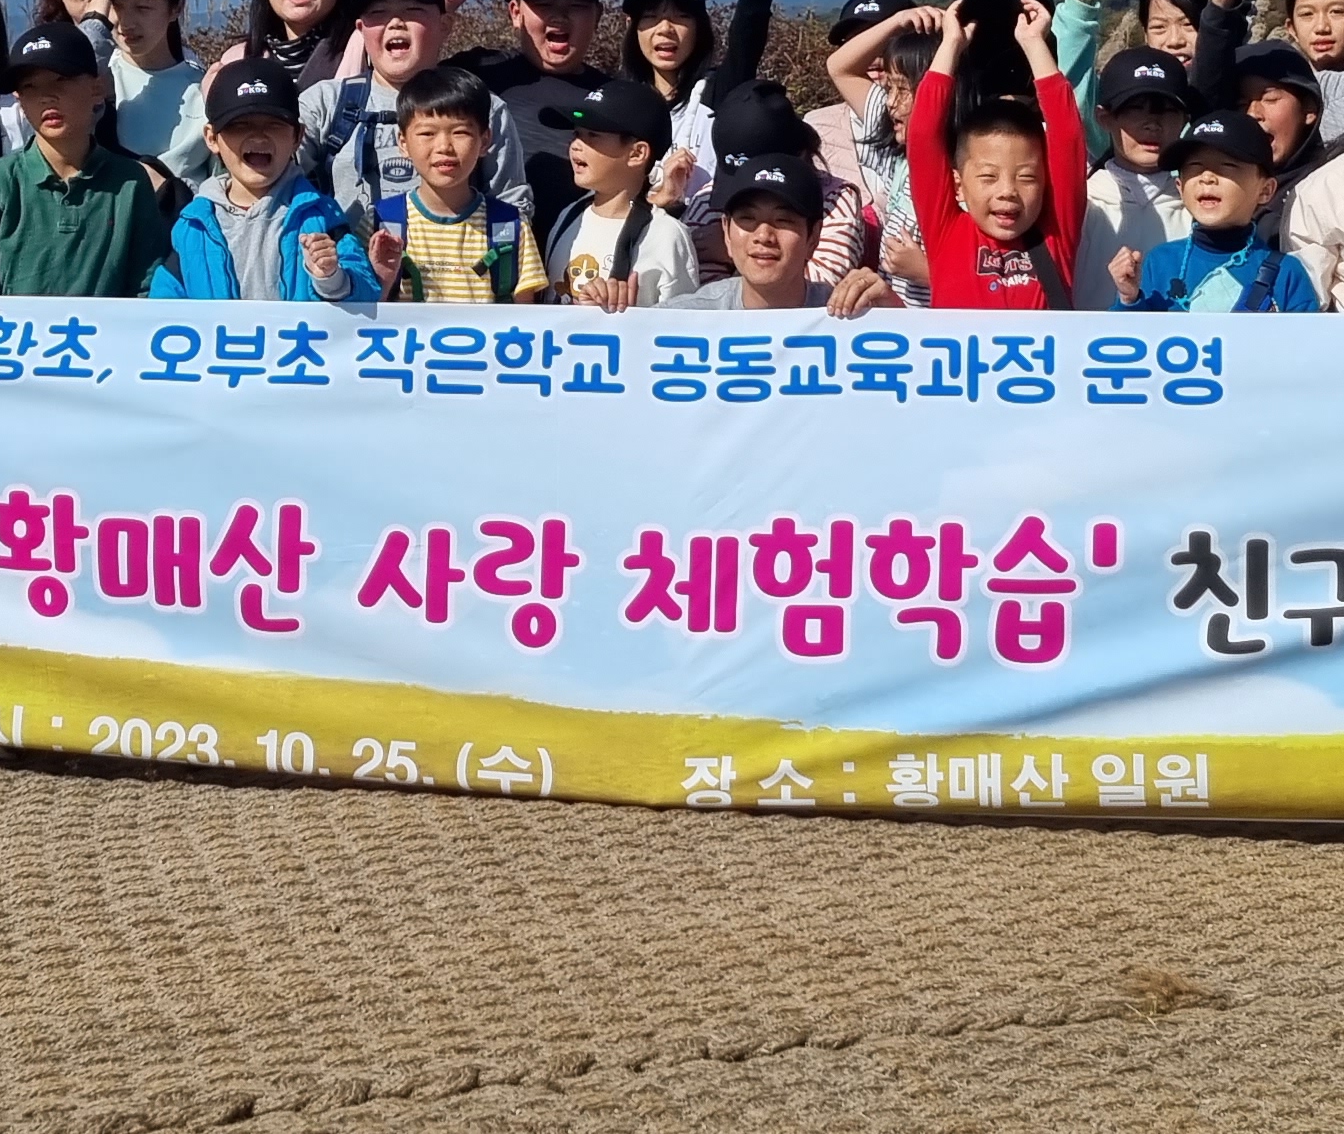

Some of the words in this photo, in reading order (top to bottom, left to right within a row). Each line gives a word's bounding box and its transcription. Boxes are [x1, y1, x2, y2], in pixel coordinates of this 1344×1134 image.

[140, 321, 330, 388] 오부초
[356, 325, 625, 397] 작은학교
[651, 331, 1056, 404] 공동교육과정
[1082, 336, 1225, 405] 운영
[357, 519, 581, 649] 사랑
[622, 515, 1118, 664] 체험학습'
[88, 716, 236, 767] 2023.
[256, 729, 331, 776] 10.
[352, 737, 434, 785] 25.
[456, 742, 553, 797] (수)
[885, 753, 1069, 808] 황매산
[1091, 753, 1210, 808] 일원
